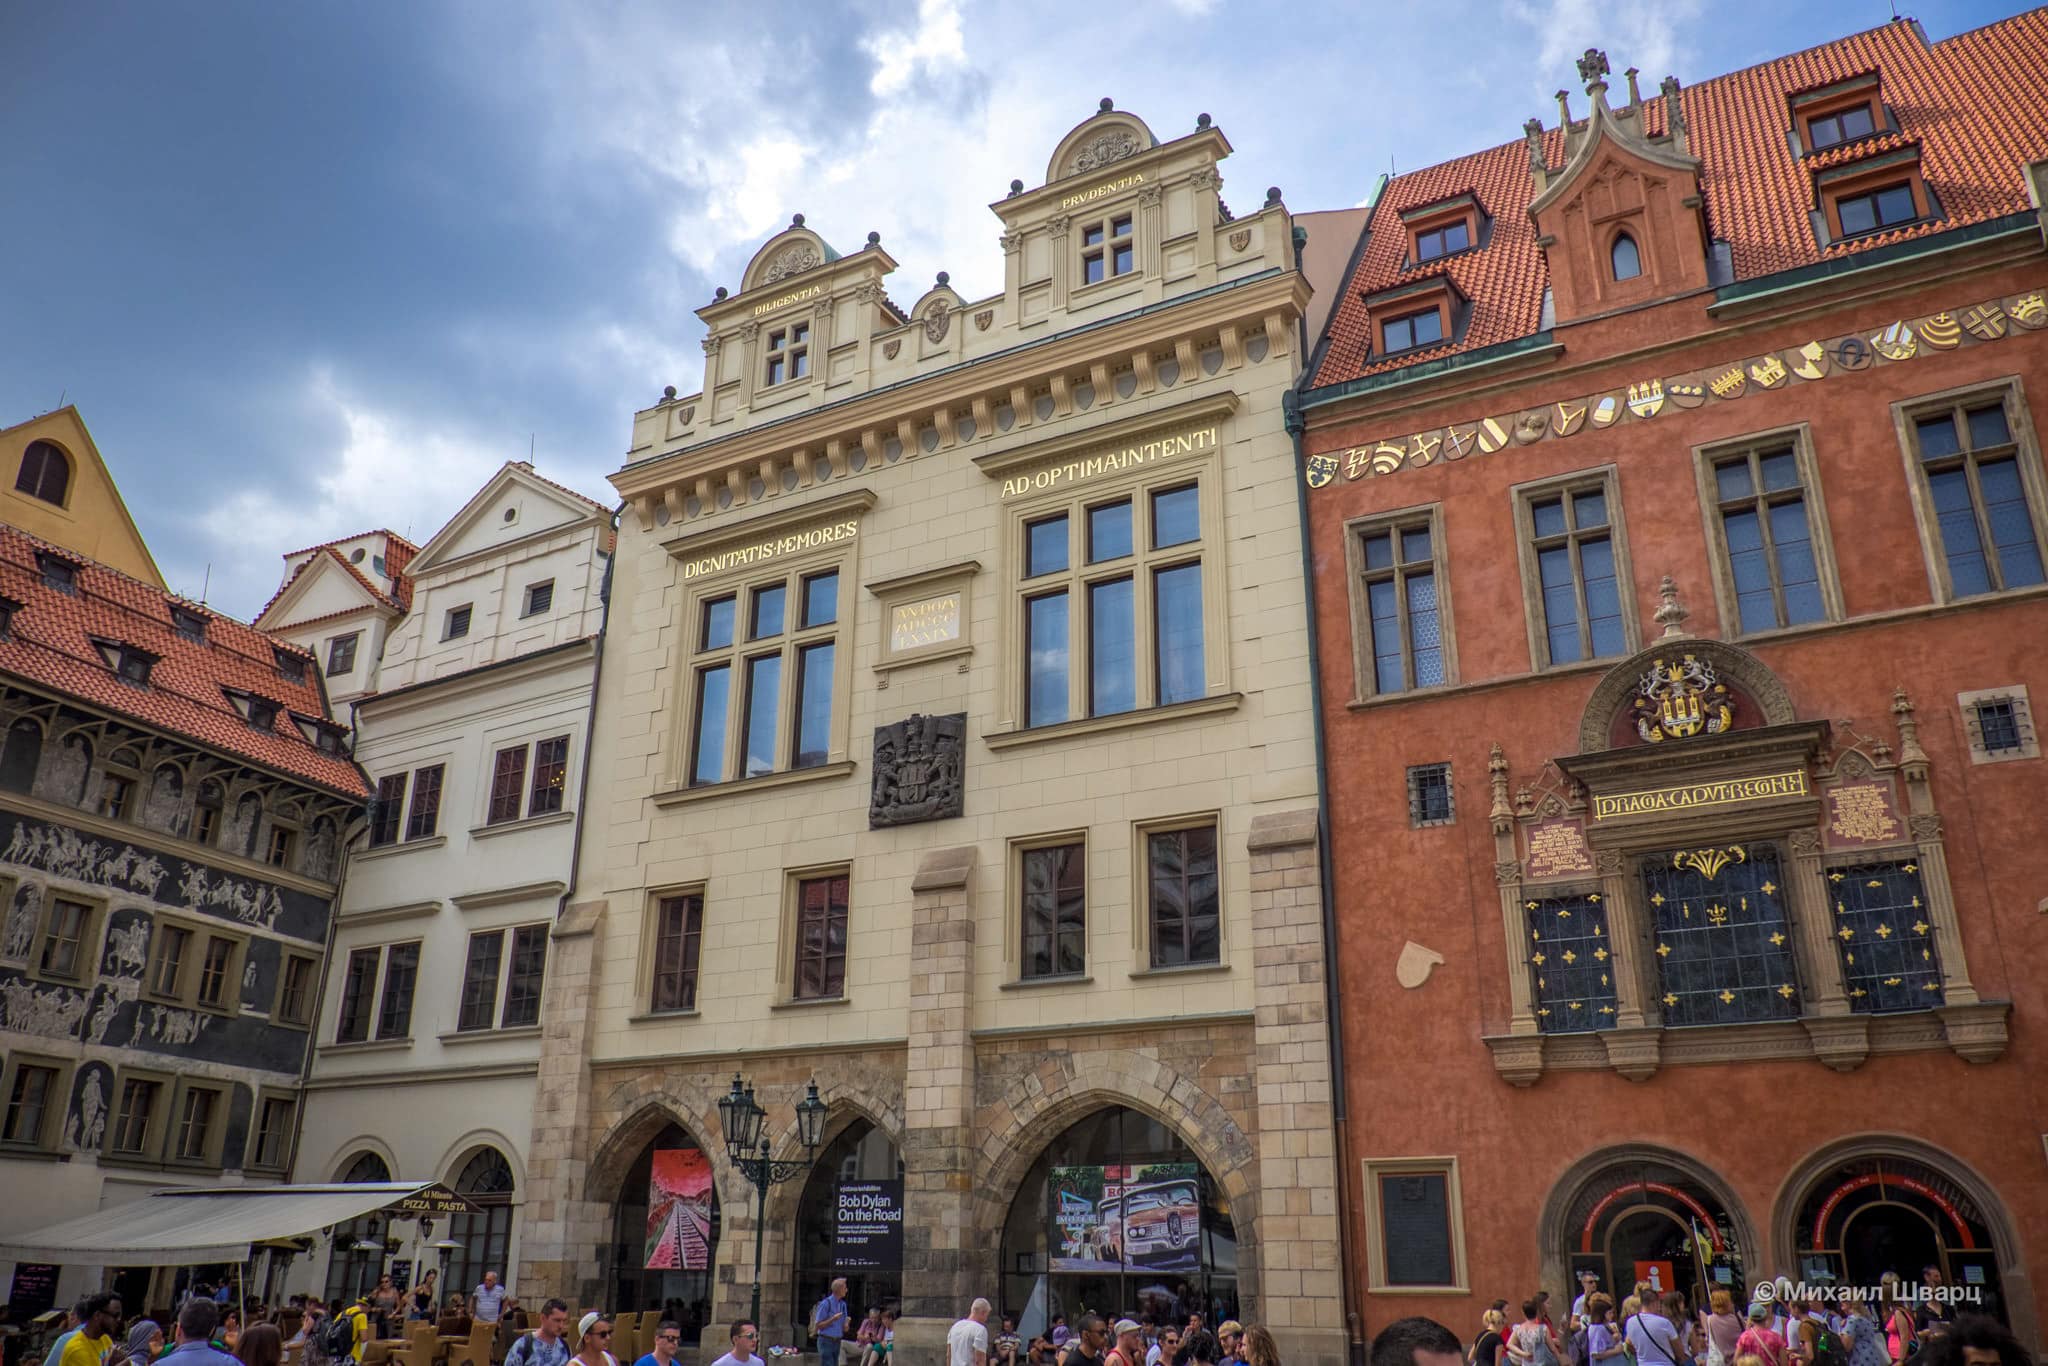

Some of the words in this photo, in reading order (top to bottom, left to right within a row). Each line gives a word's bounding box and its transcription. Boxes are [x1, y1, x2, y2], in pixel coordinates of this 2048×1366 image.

[1062, 174, 1143, 208] PRVDENTIA
[754, 285, 820, 315] DILIGENTIA
[403, 1200, 431, 1210] PIZZA
[437, 1202, 467, 1212] PASTA
[839, 1194, 861, 1208] Bob
[862, 1194, 891, 1210] Dylan
[838, 1208, 854, 1222] On
[855, 1208, 872, 1222] the
[873, 1208, 902, 1222] Road
